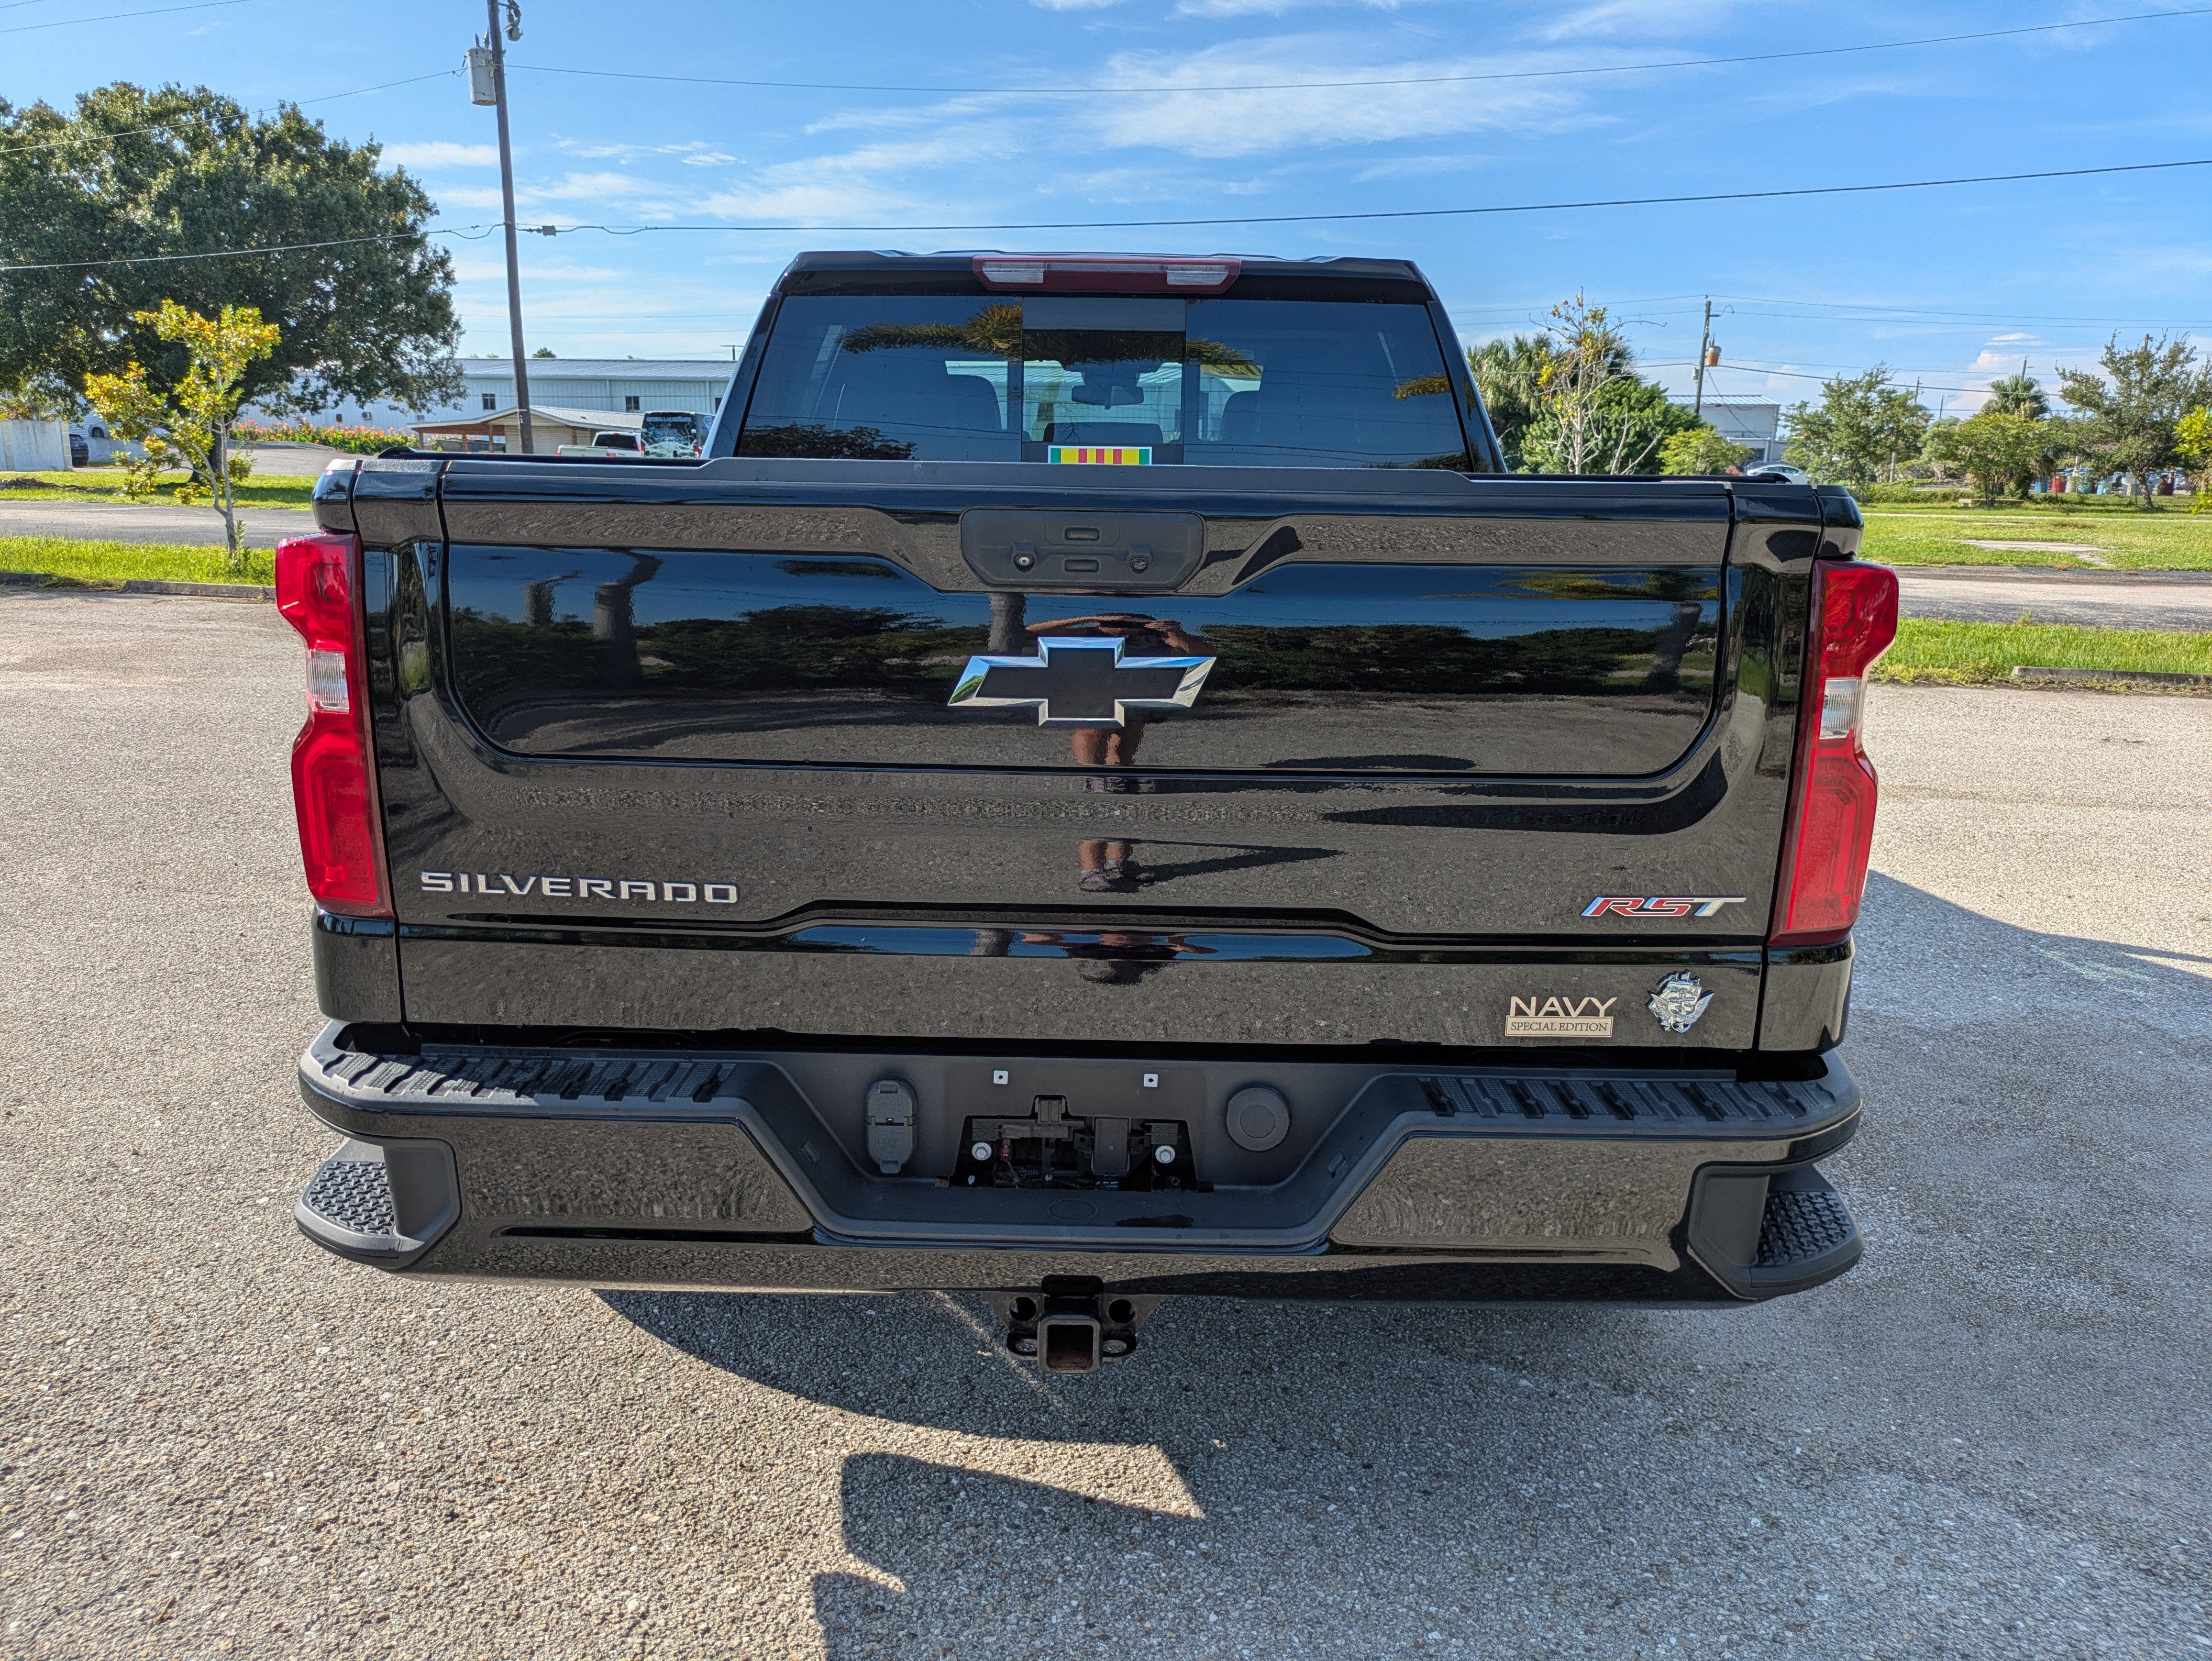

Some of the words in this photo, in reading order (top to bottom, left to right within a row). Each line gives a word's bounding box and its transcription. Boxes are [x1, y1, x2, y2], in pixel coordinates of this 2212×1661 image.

[421, 871, 739, 904] SILVERADO
[1581, 897, 1747, 916] RST
[1510, 996, 1617, 1017] NAVY
[1511, 1022, 1557, 1030] SPECIAL
[1558, 1022, 1608, 1031] EDITION
